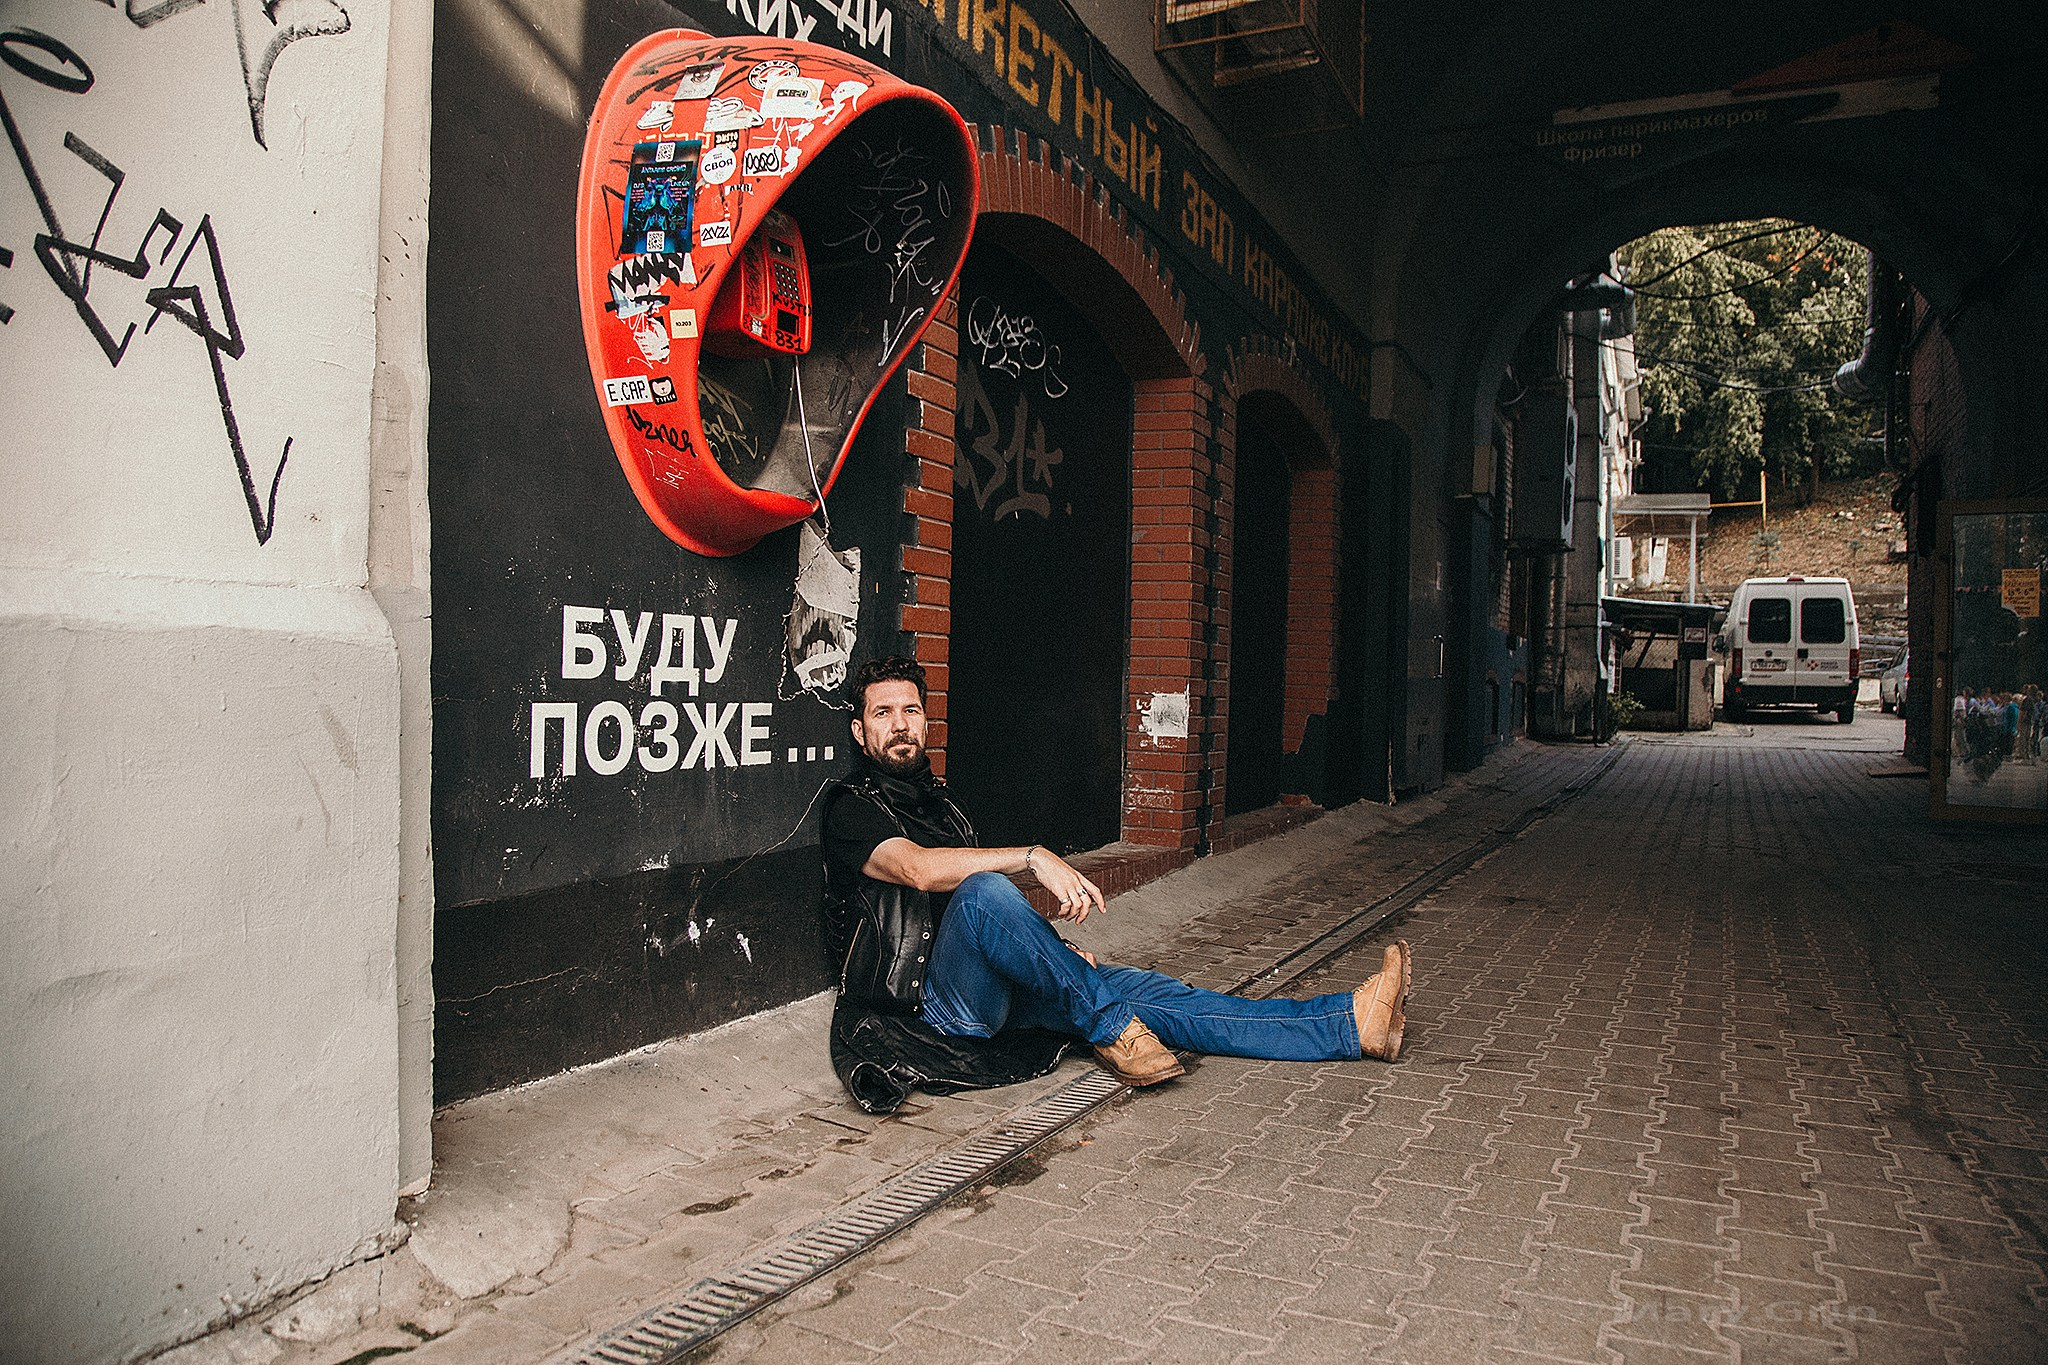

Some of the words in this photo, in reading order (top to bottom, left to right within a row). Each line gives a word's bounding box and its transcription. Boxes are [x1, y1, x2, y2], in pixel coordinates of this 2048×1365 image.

[1535, 126, 1605, 147] Школа
[1611, 108, 1769, 138] парикмахеров
[704, 158, 733, 172] СВОЯ
[1181, 169, 1235, 276] ЗАЛ
[775, 329, 804, 352] 831
[606, 379, 649, 402] E.CAP.
[561, 604, 739, 697] БУДУ
